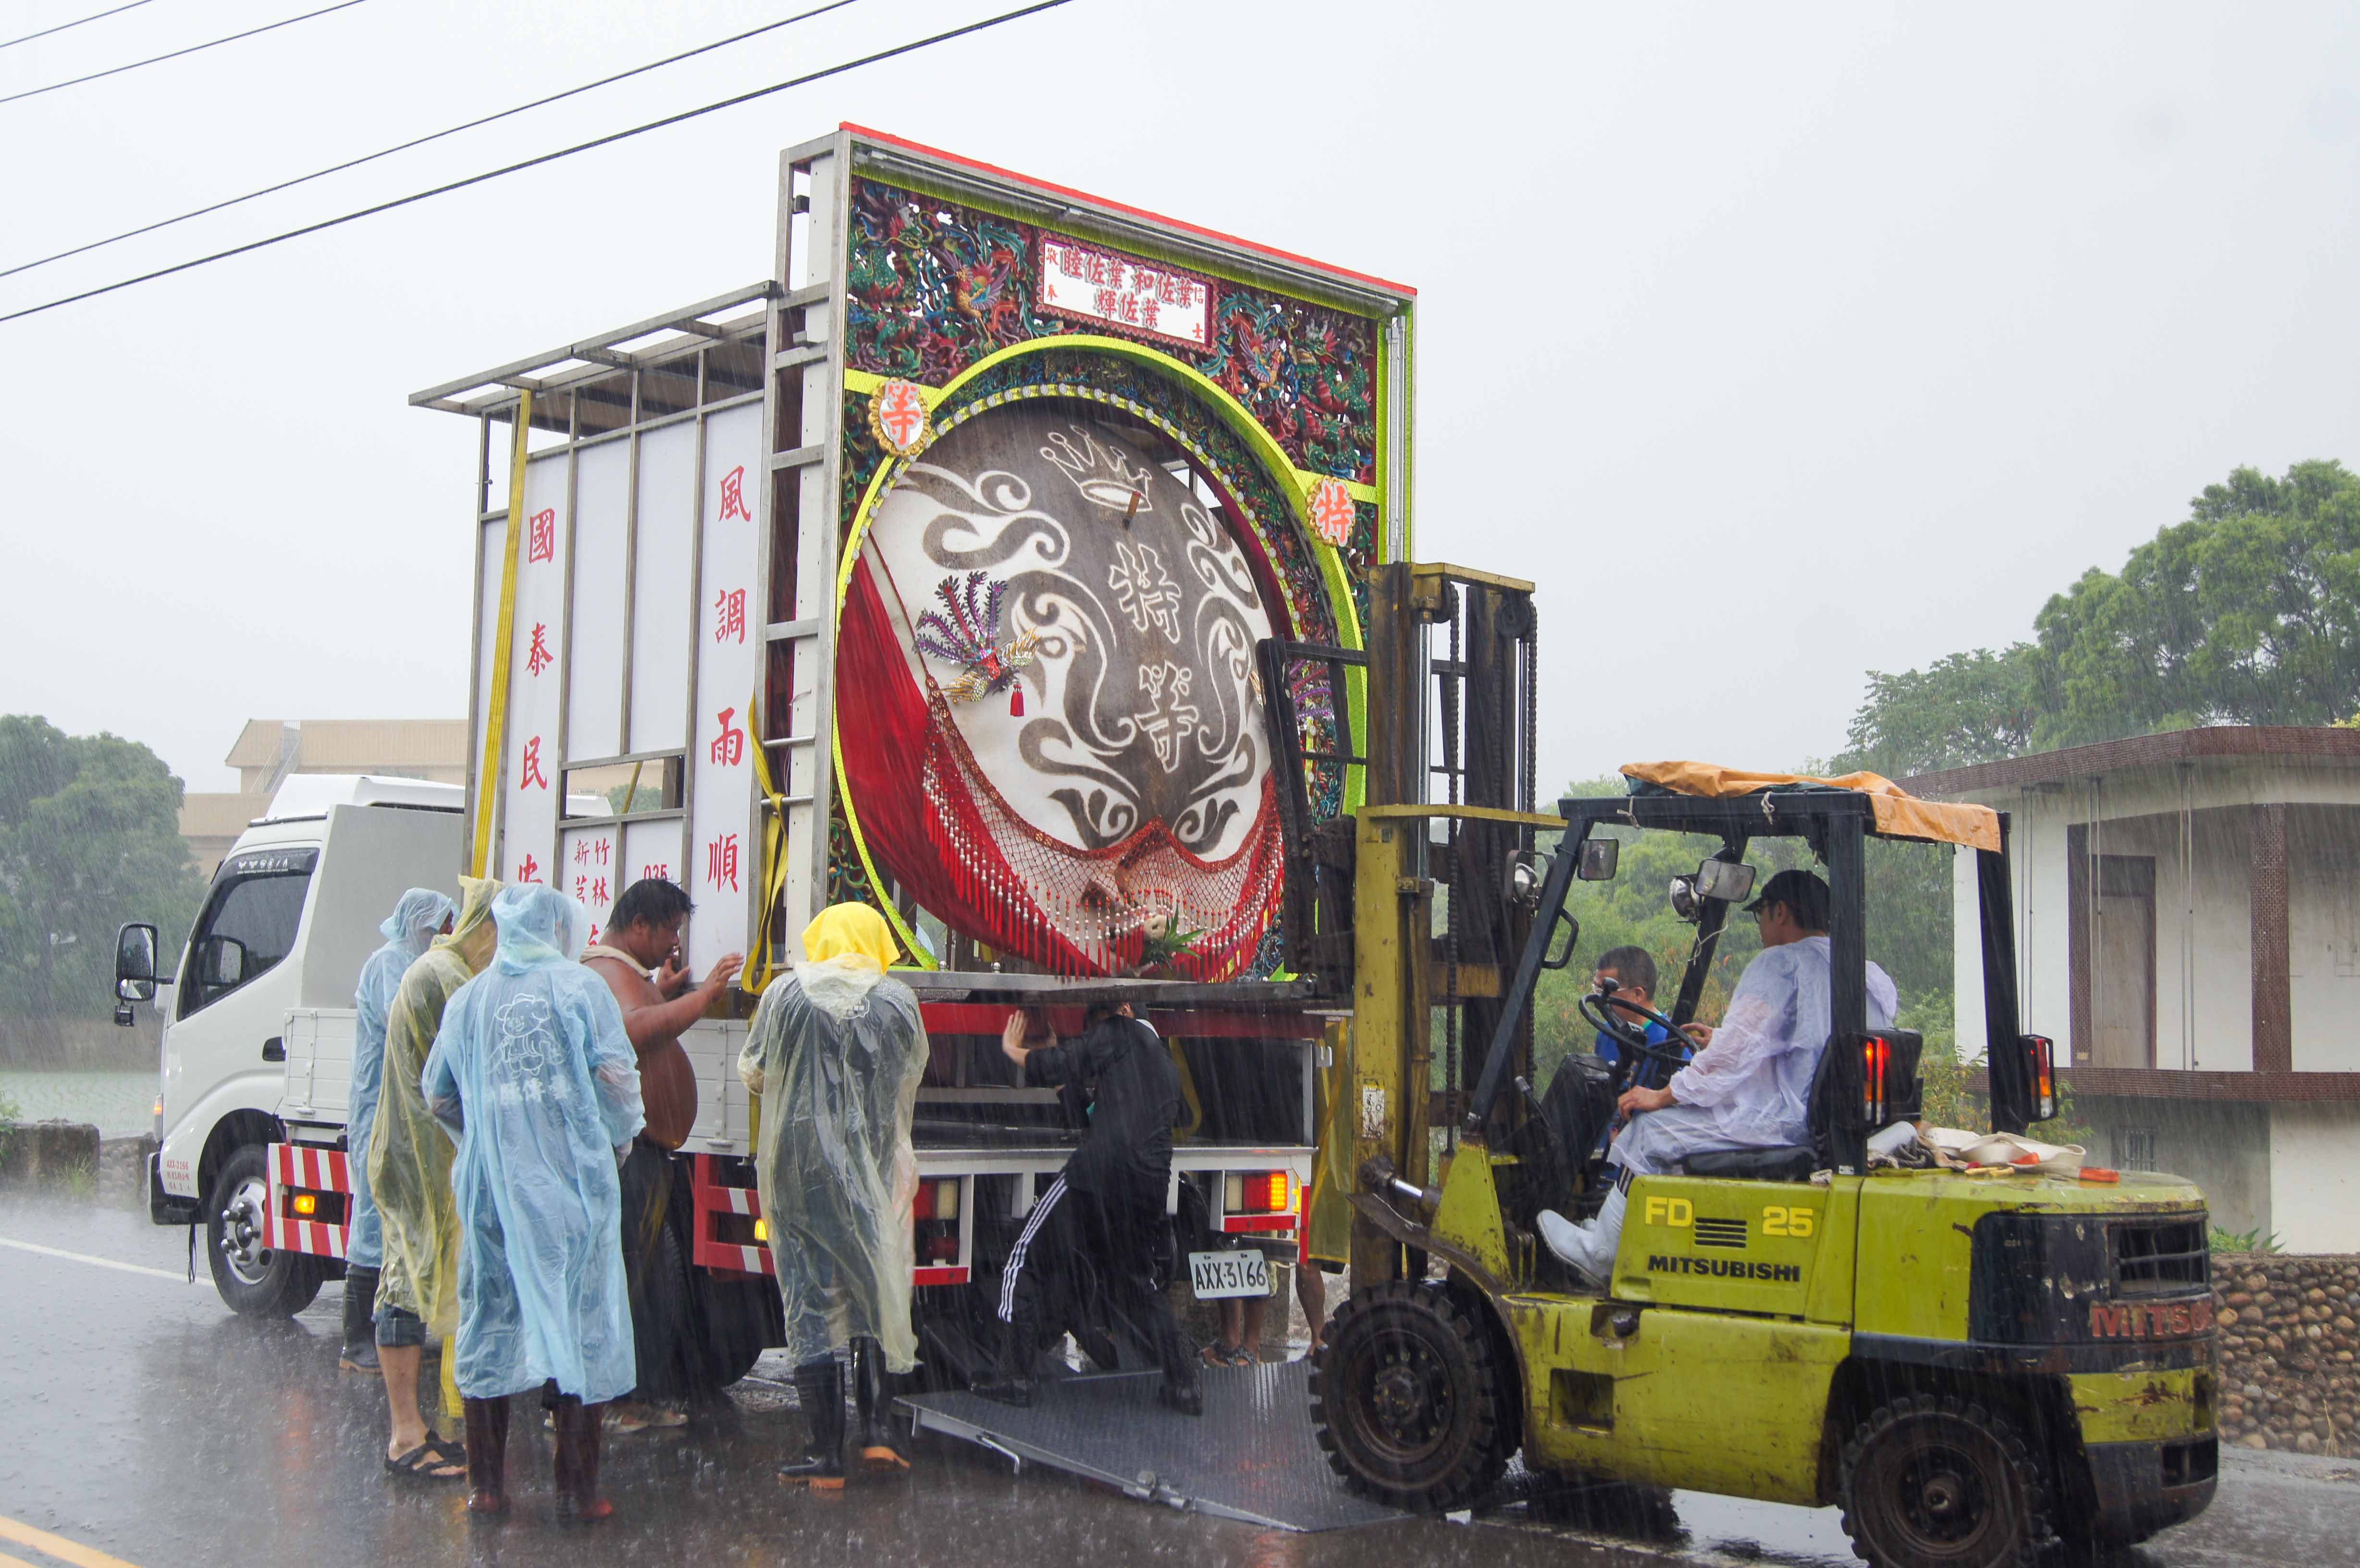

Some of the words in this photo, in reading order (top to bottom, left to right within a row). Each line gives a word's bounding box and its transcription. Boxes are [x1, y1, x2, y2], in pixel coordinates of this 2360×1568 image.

[1192, 287, 1205, 339] 信士
[708, 465, 751, 893] 風調雨順
[574, 837, 610, 867] 新竹
[1645, 1196, 1694, 1227] FD
[1761, 1205, 1814, 1238] 25
[1647, 1254, 1801, 1282] MITSUBISHI
